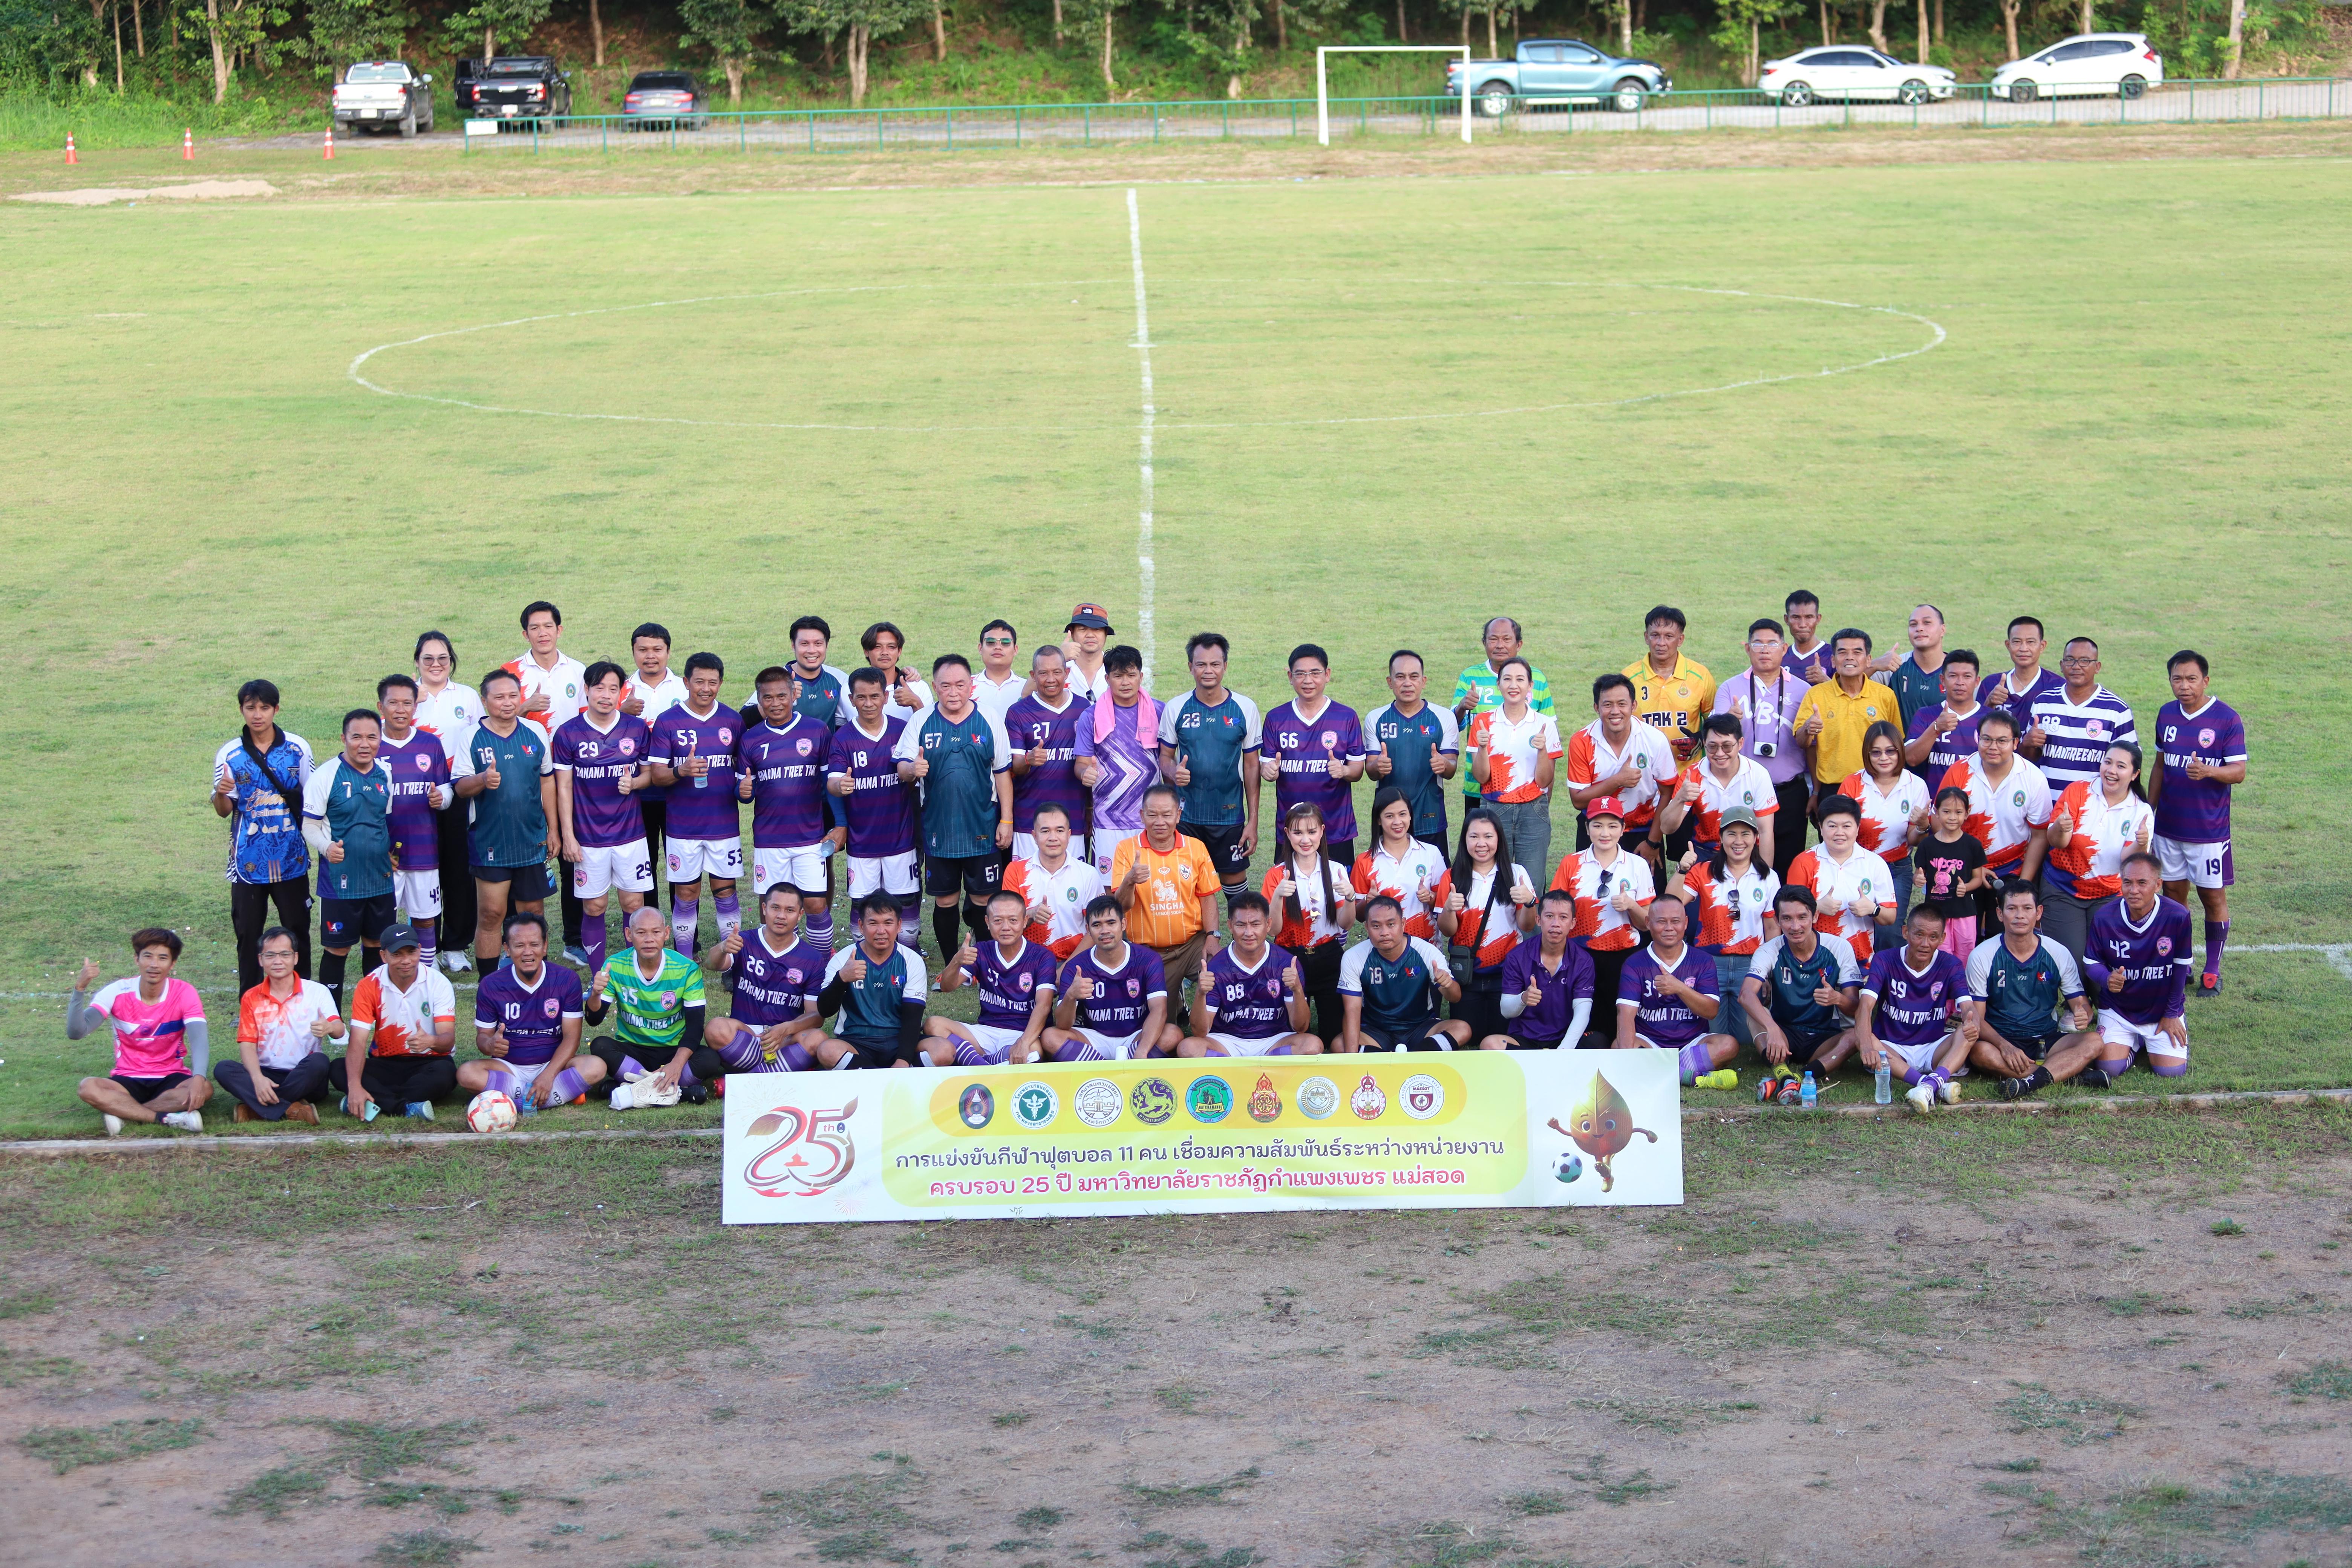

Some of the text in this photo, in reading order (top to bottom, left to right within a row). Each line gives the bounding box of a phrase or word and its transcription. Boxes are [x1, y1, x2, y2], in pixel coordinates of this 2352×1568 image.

[1641, 686, 1649, 701] 3
[1181, 712, 1200, 728] 23
[1641, 711, 1672, 728] TAK
[2041, 715, 2061, 732] 88
[676, 729, 698, 746] 53
[1032, 721, 1050, 740] 27
[1380, 722, 1398, 740] 50
[2163, 725, 2177, 743] 19
[925, 732, 943, 749] 57
[1279, 732, 1299, 749] 66
[579, 741, 600, 758] 29
[760, 743, 770, 760] 7
[706, 755, 726, 768] TREE
[853, 750, 868, 768] 18
[1305, 759, 1328, 774] TREE
[1928, 751, 1956, 766] ANANA
[783, 765, 804, 779] TREE
[342, 781, 352, 798] 7
[403, 782, 424, 795] TREE
[728, 848, 743, 866] 53
[635, 860, 653, 880] 29
[820, 861, 825, 878] 7
[985, 863, 1000, 882] 57
[2206, 858, 2220, 876] 19
[429, 886, 440, 904] 45
[1150, 902, 1184, 911] SINGHA
[2110, 940, 2131, 958] 42
[746, 954, 765, 976] 26
[2142, 966, 2164, 980] TREE
[1997, 969, 2006, 988] 2
[620, 986, 639, 1005] 35
[767, 989, 788, 1005] TREE
[980, 988, 1006, 1009] BANANA
[1008, 1000, 1027, 1011] TREE
[1226, 982, 1245, 1002] 88
[505, 1003, 521, 1020] 10
[1113, 1007, 1134, 1021] TREE
[1251, 1007, 1275, 1021] TREE
[1670, 1008, 1693, 1021] TREE
[646, 1018, 668, 1030] TREE
[896, 1135, 1504, 1170] การแข่งขันกีฬาฟุตบอล 11 คน เชื่อมความสัมพันธ์ระหว่างหน่วยงาน
[931, 1164, 1465, 1196] ครบรอบ 25 ปี มหาวิทยาลัยราชภัฏกำแพงเพชร แม่สอด
